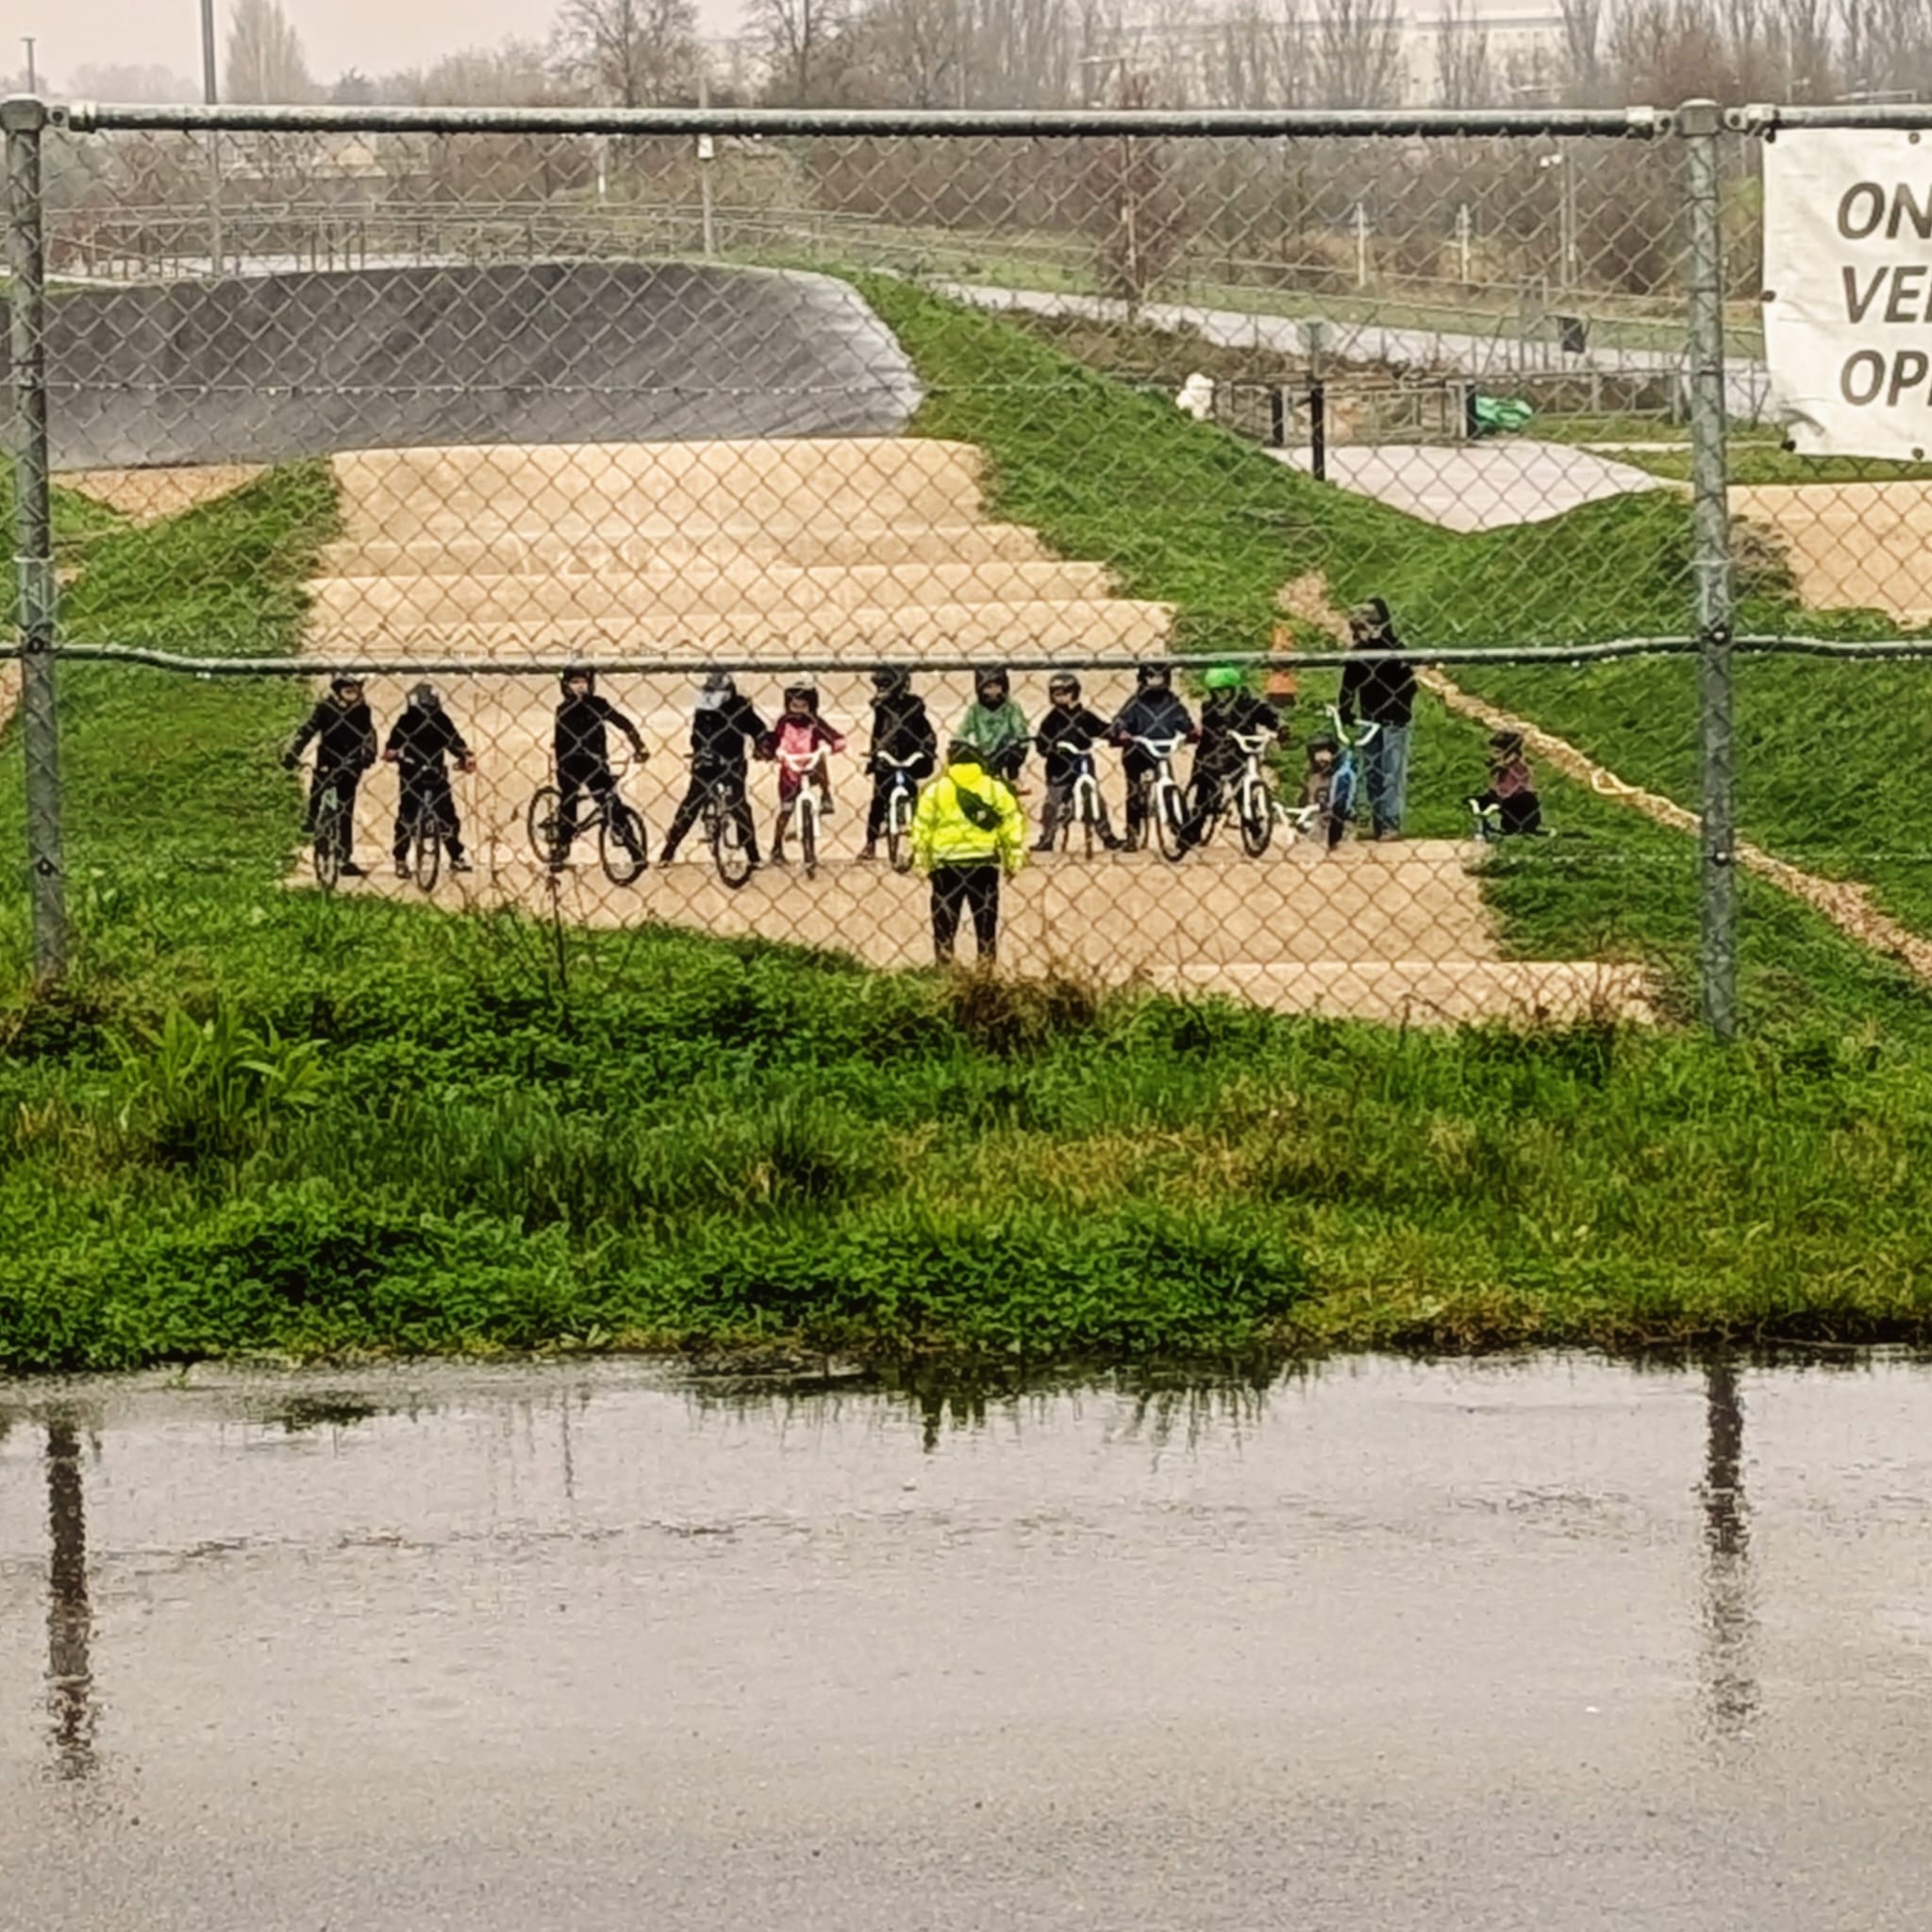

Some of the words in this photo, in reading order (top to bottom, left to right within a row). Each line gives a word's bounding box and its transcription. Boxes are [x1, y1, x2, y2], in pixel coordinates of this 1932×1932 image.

[1837, 181, 1932, 240] ON
[1842, 265, 1932, 324] VE
[1840, 349, 1932, 407] OP
